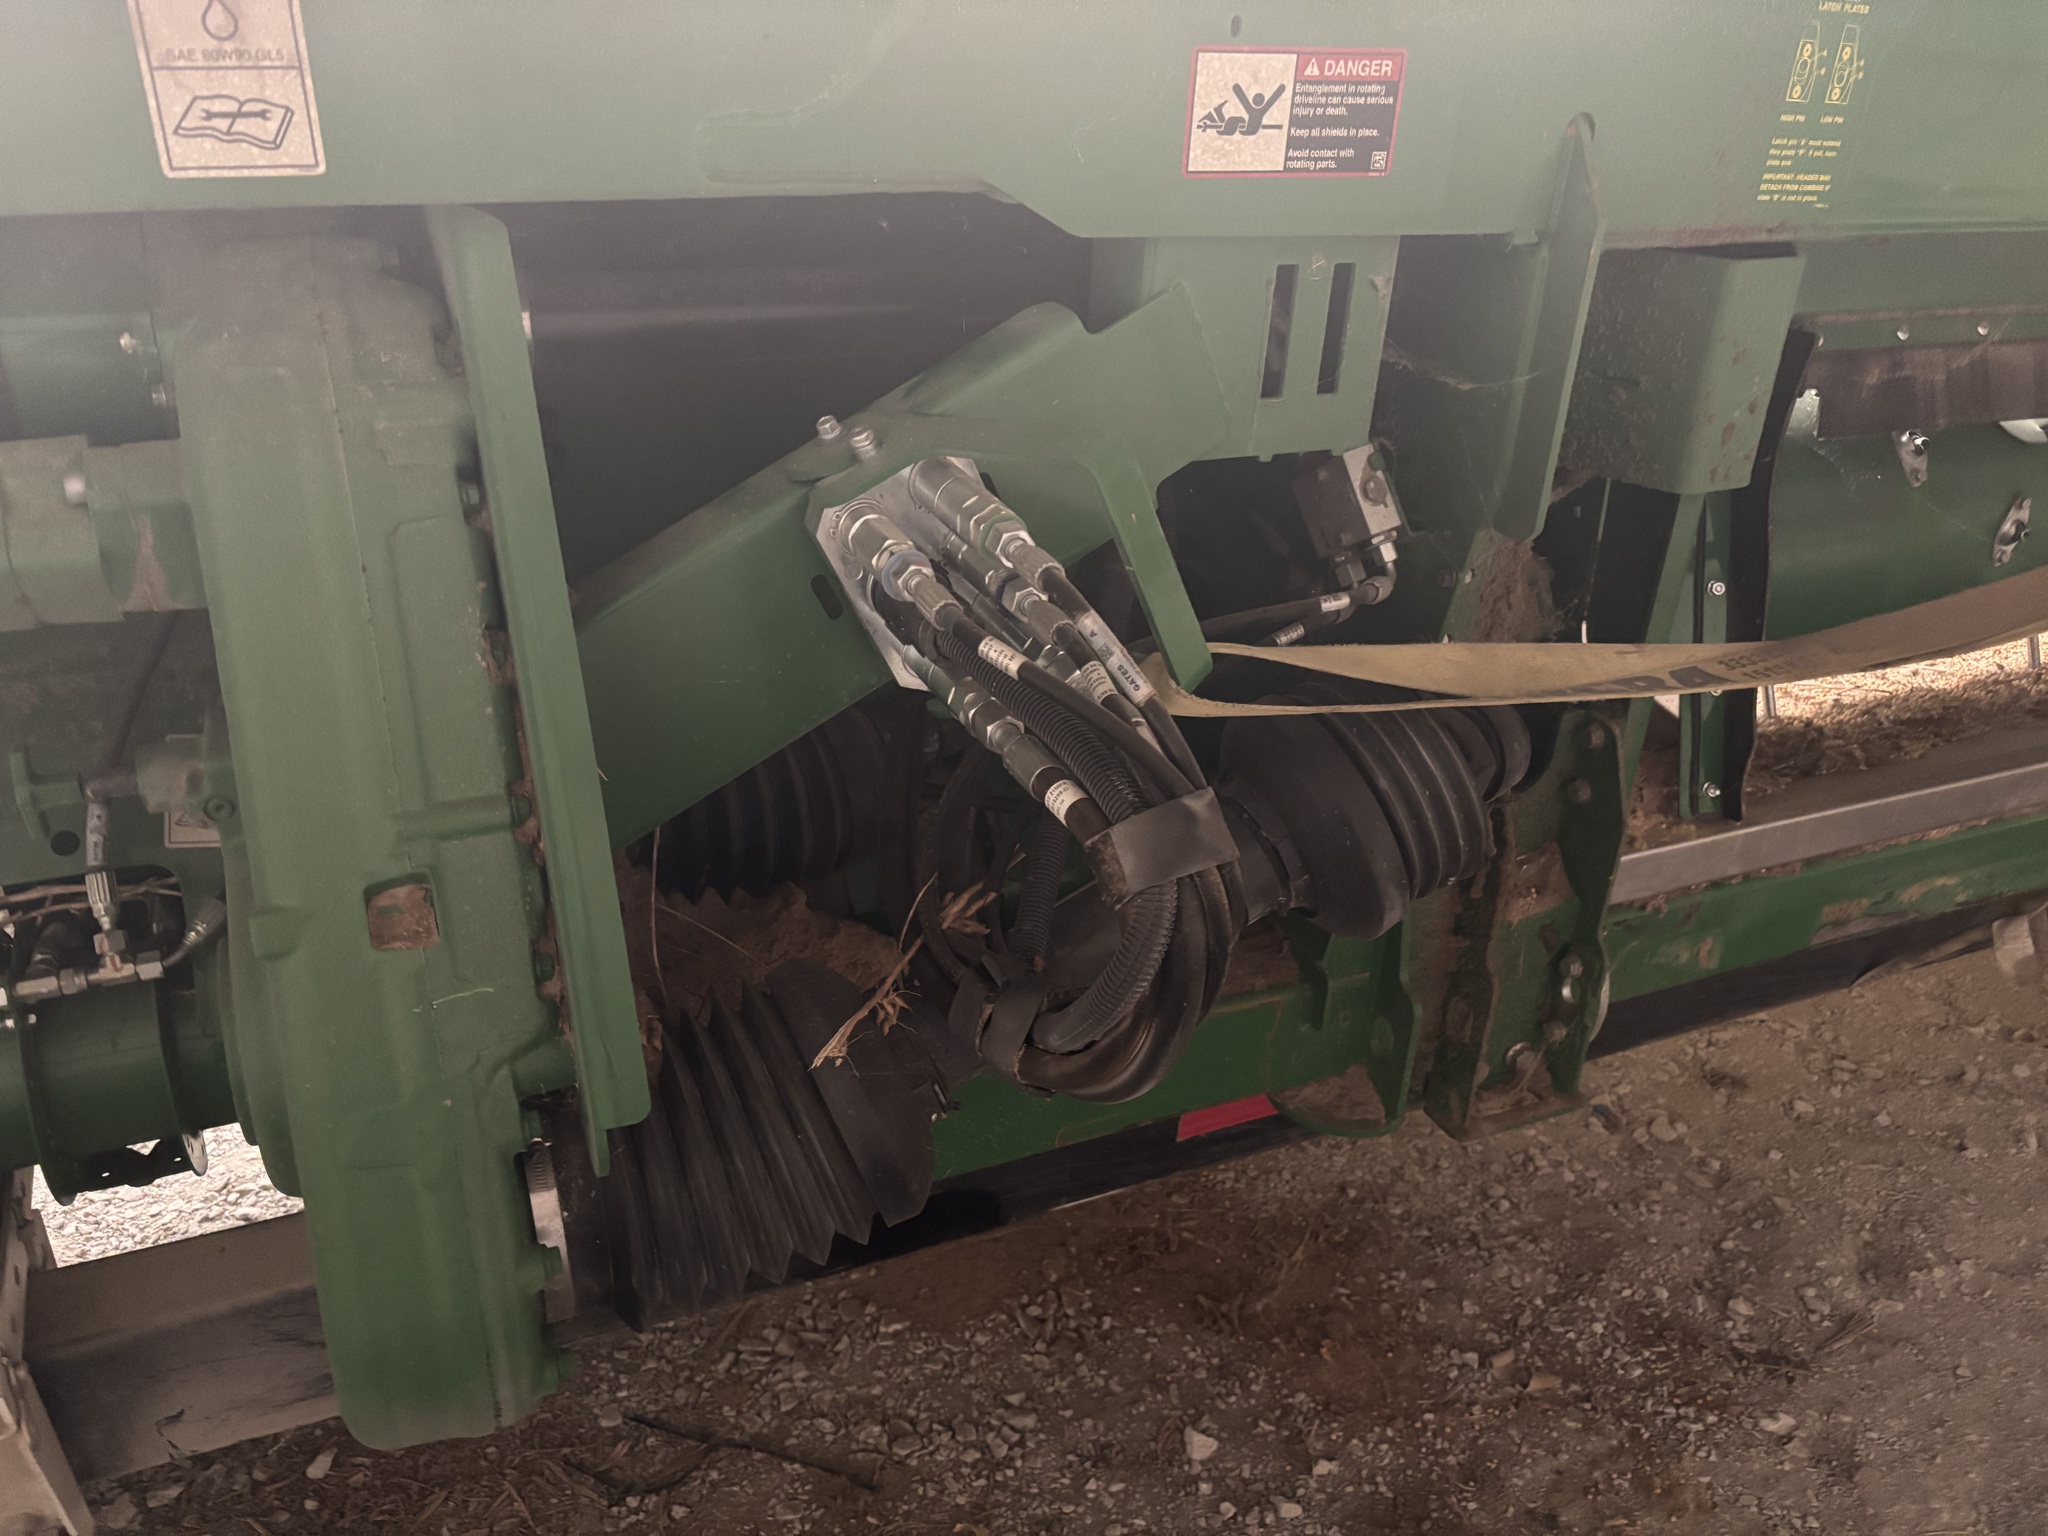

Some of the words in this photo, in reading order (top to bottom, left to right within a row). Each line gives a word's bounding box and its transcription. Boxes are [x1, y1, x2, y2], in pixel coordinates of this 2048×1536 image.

[1843, 3, 1870, 14] PLATES
[165, 48, 196, 62] SAE
[1323, 59, 1394, 77] DANGER
[1295, 83, 1347, 95] Entanglement
[1348, 84, 1356, 93] in
[1357, 83, 1386, 95] rotating
[1294, 94, 1327, 104] driveline
[1327, 96, 1341, 104] can
[1342, 96, 1365, 104] cause
[1367, 95, 1394, 105] serious
[1293, 105, 1315, 117] injury
[1316, 107, 1324, 115] or
[1325, 106, 1348, 116] death.
[1290, 127, 1309, 139] Keep
[1311, 127, 1320, 137] all
[1321, 127, 1348, 137] shields
[1349, 127, 1357, 137] in
[1357, 127, 1380, 138] place.
[1288, 148, 1309, 158] Avoid
[1310, 148, 1338, 158] contact
[1339, 148, 1355, 158] with
[1286, 159, 1315, 171] rotating
[1316, 160, 1338, 171] parts.
[1116, 663, 1141, 692] GATES
